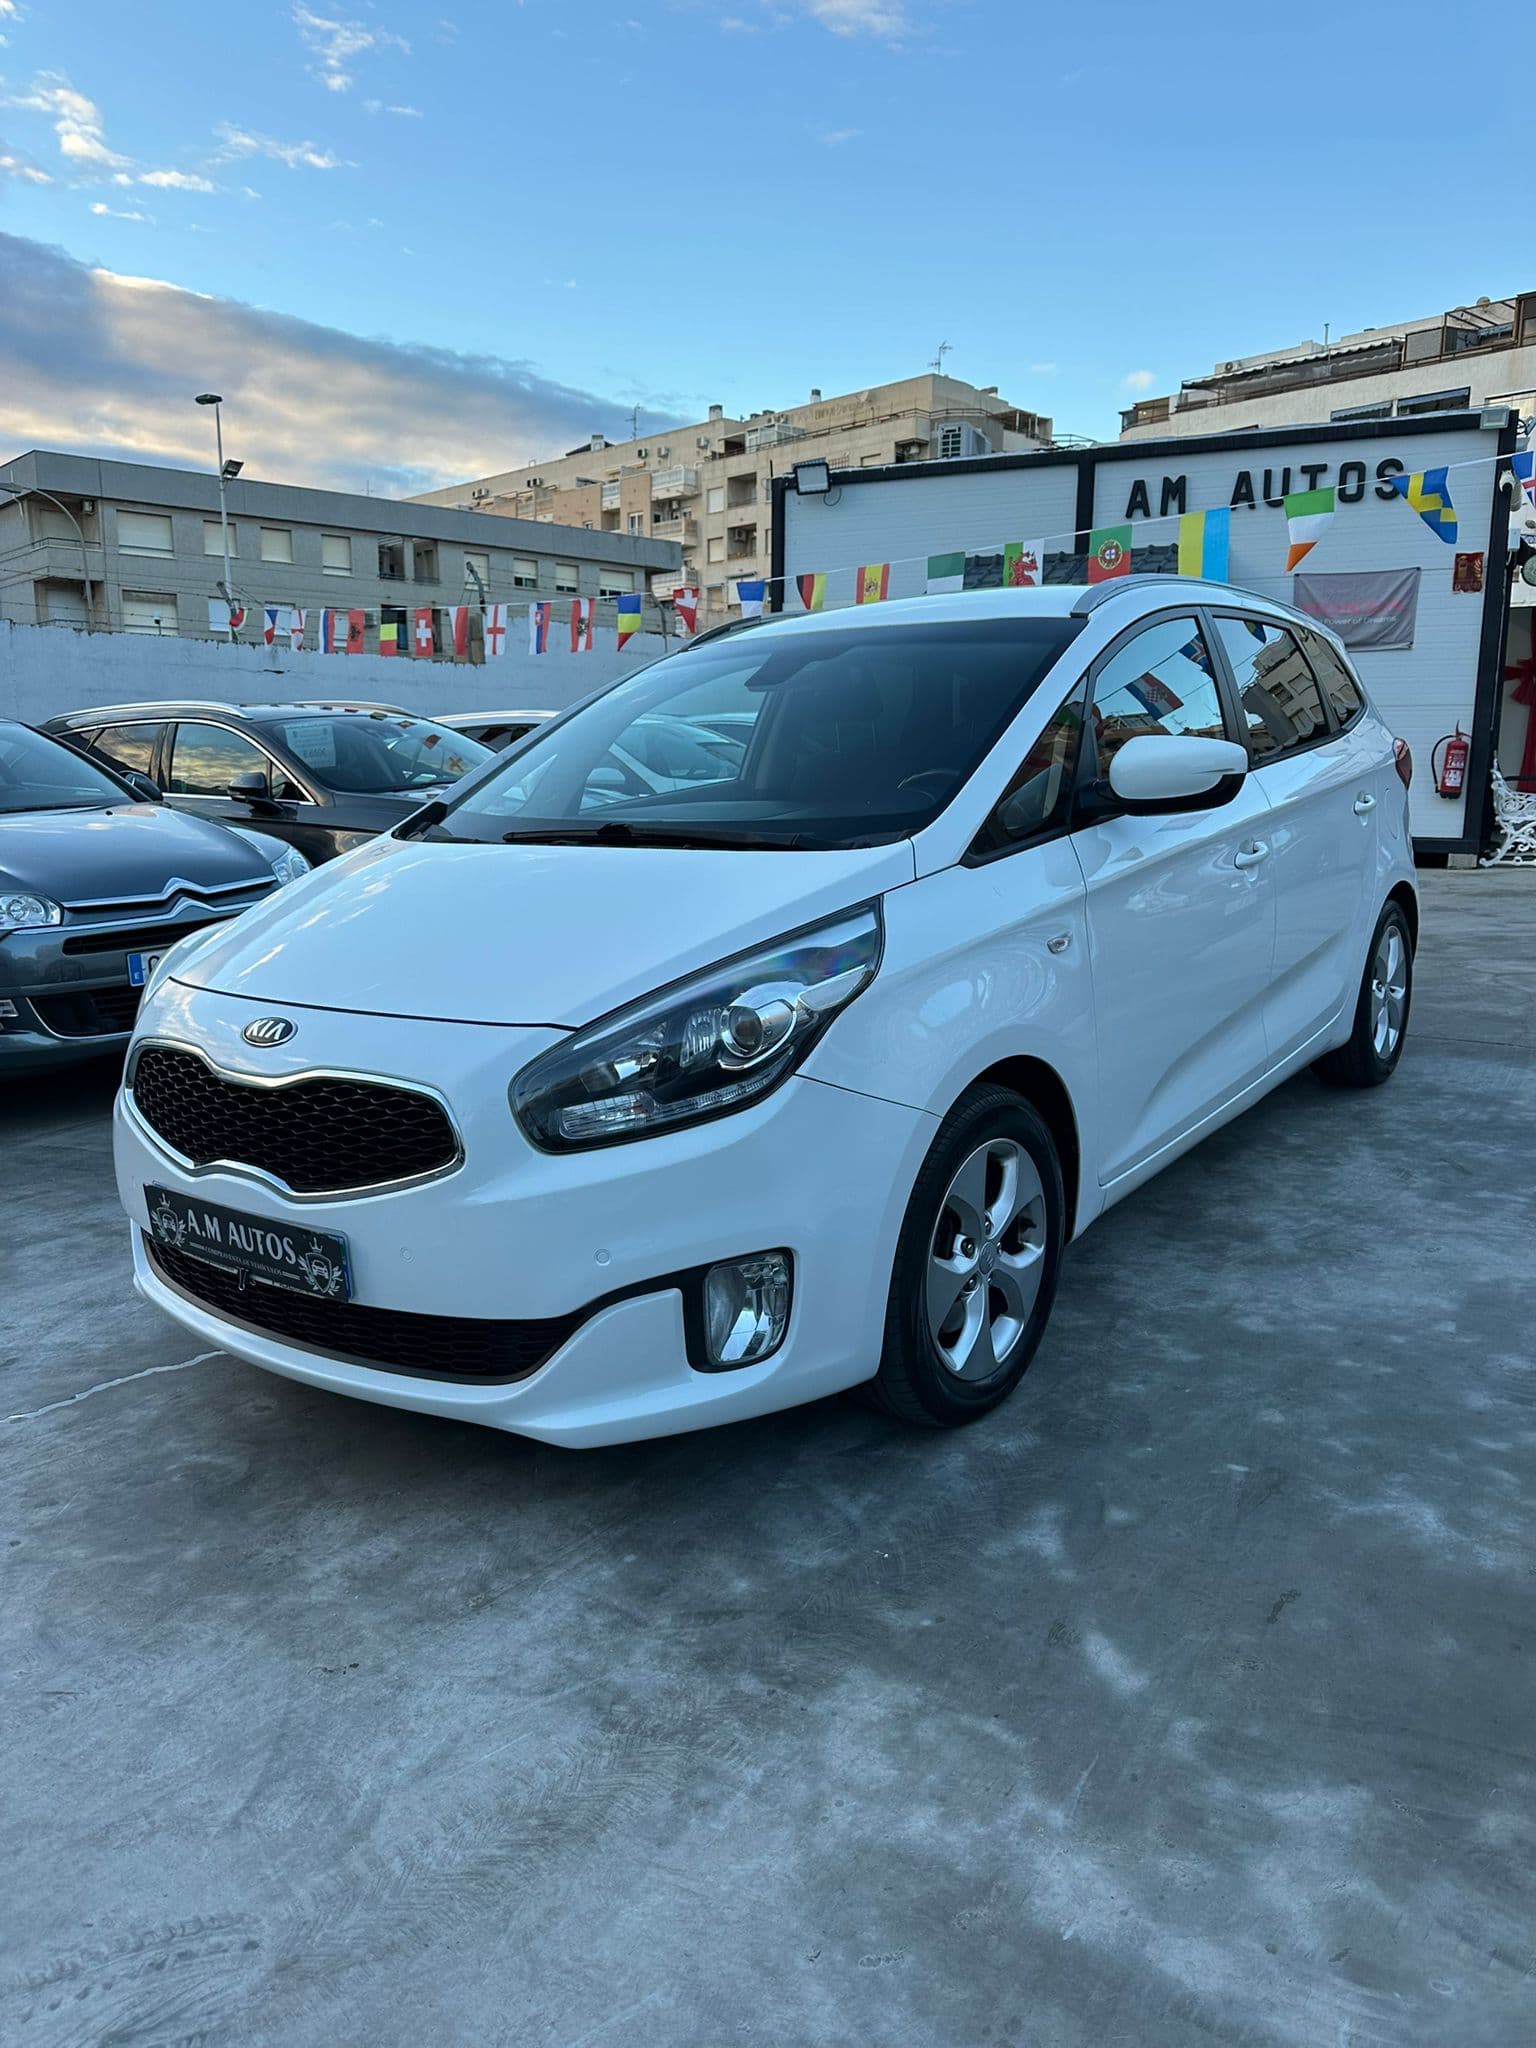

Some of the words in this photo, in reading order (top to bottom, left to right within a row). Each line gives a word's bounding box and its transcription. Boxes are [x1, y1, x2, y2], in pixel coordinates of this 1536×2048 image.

[1125, 474, 1187, 519] AM
[1229, 457, 1406, 511] AUTOS
[245, 1018, 286, 1041] KIA
[187, 1208, 222, 1243] A.M
[228, 1221, 297, 1265] AUTOS
